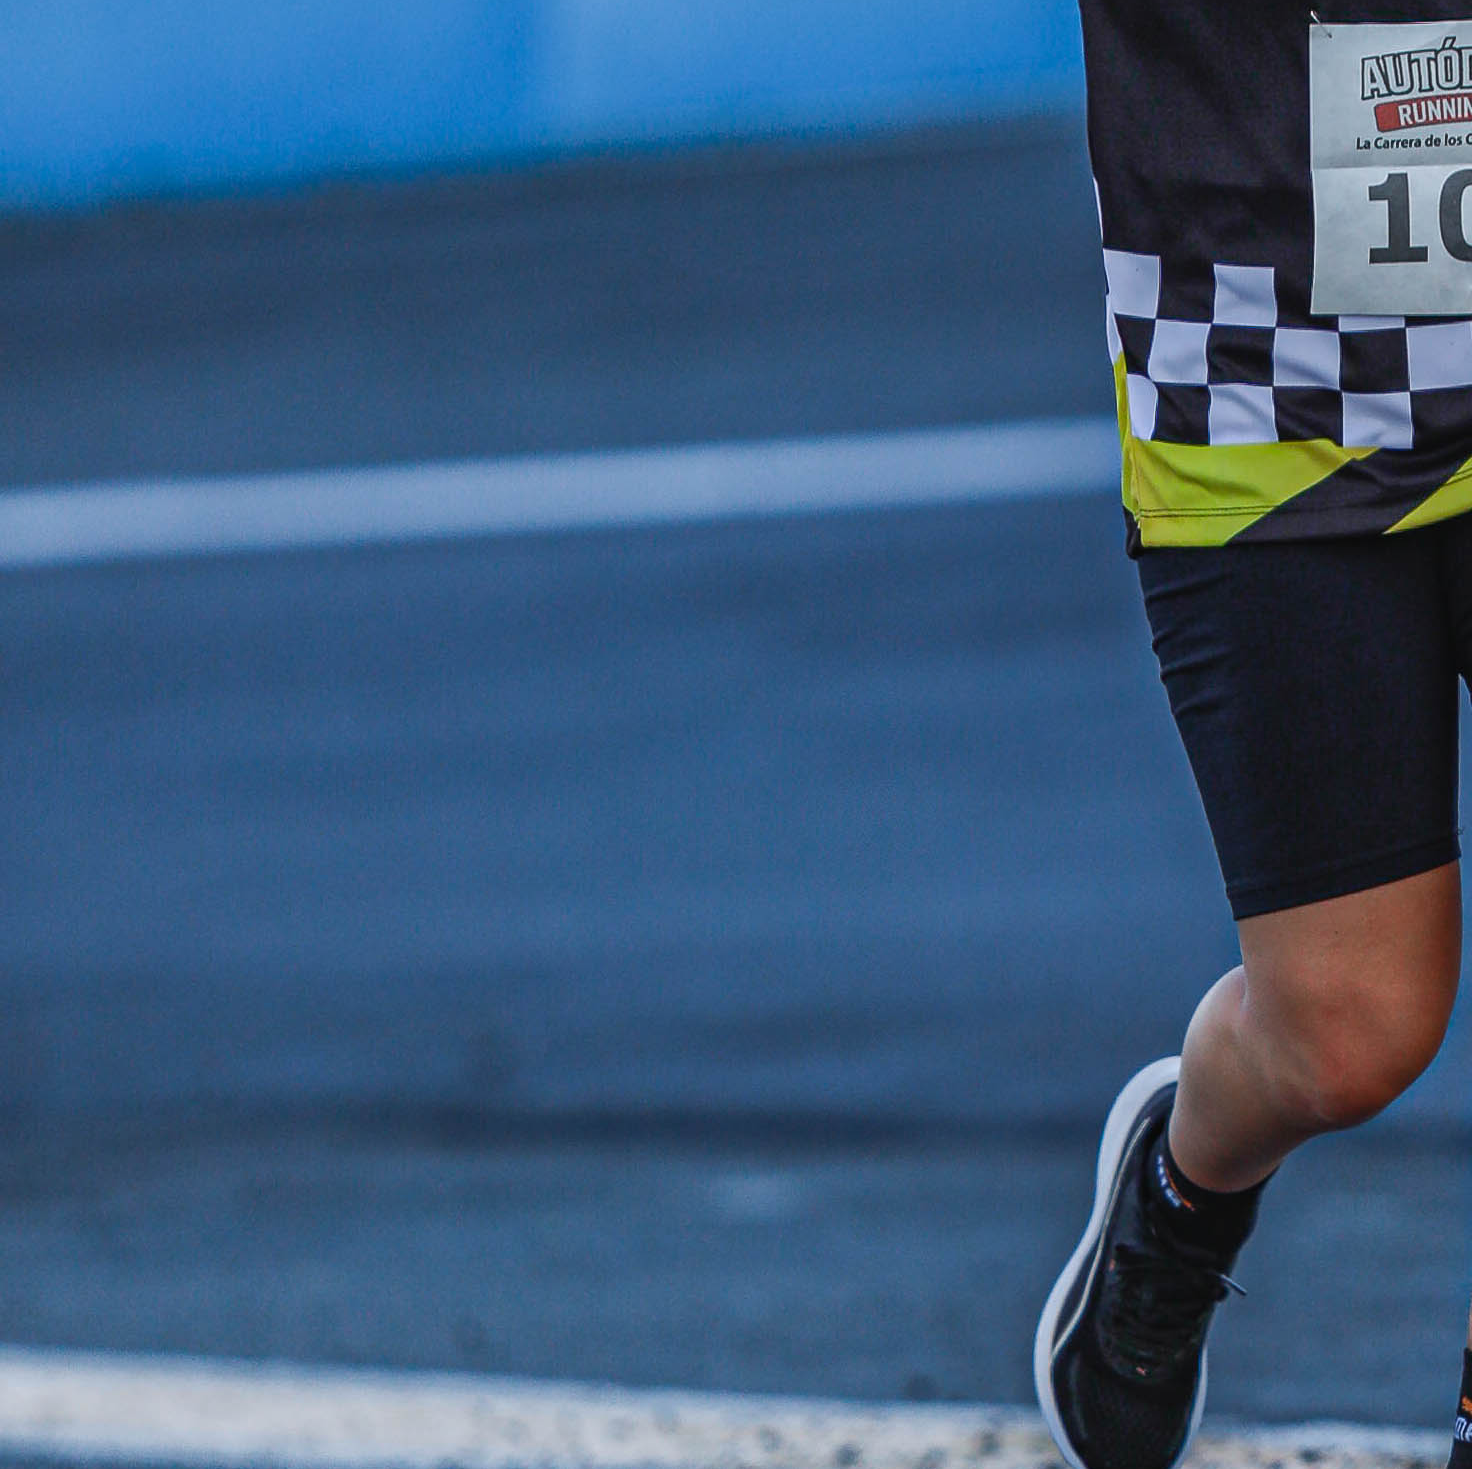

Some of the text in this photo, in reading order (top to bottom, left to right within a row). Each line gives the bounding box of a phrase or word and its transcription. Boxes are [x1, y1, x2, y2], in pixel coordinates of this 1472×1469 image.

[1356, 137, 1371, 150] La
[1374, 136, 1422, 149] Carrera
[1424, 134, 1441, 147] de
[1444, 133, 1462, 146] los
